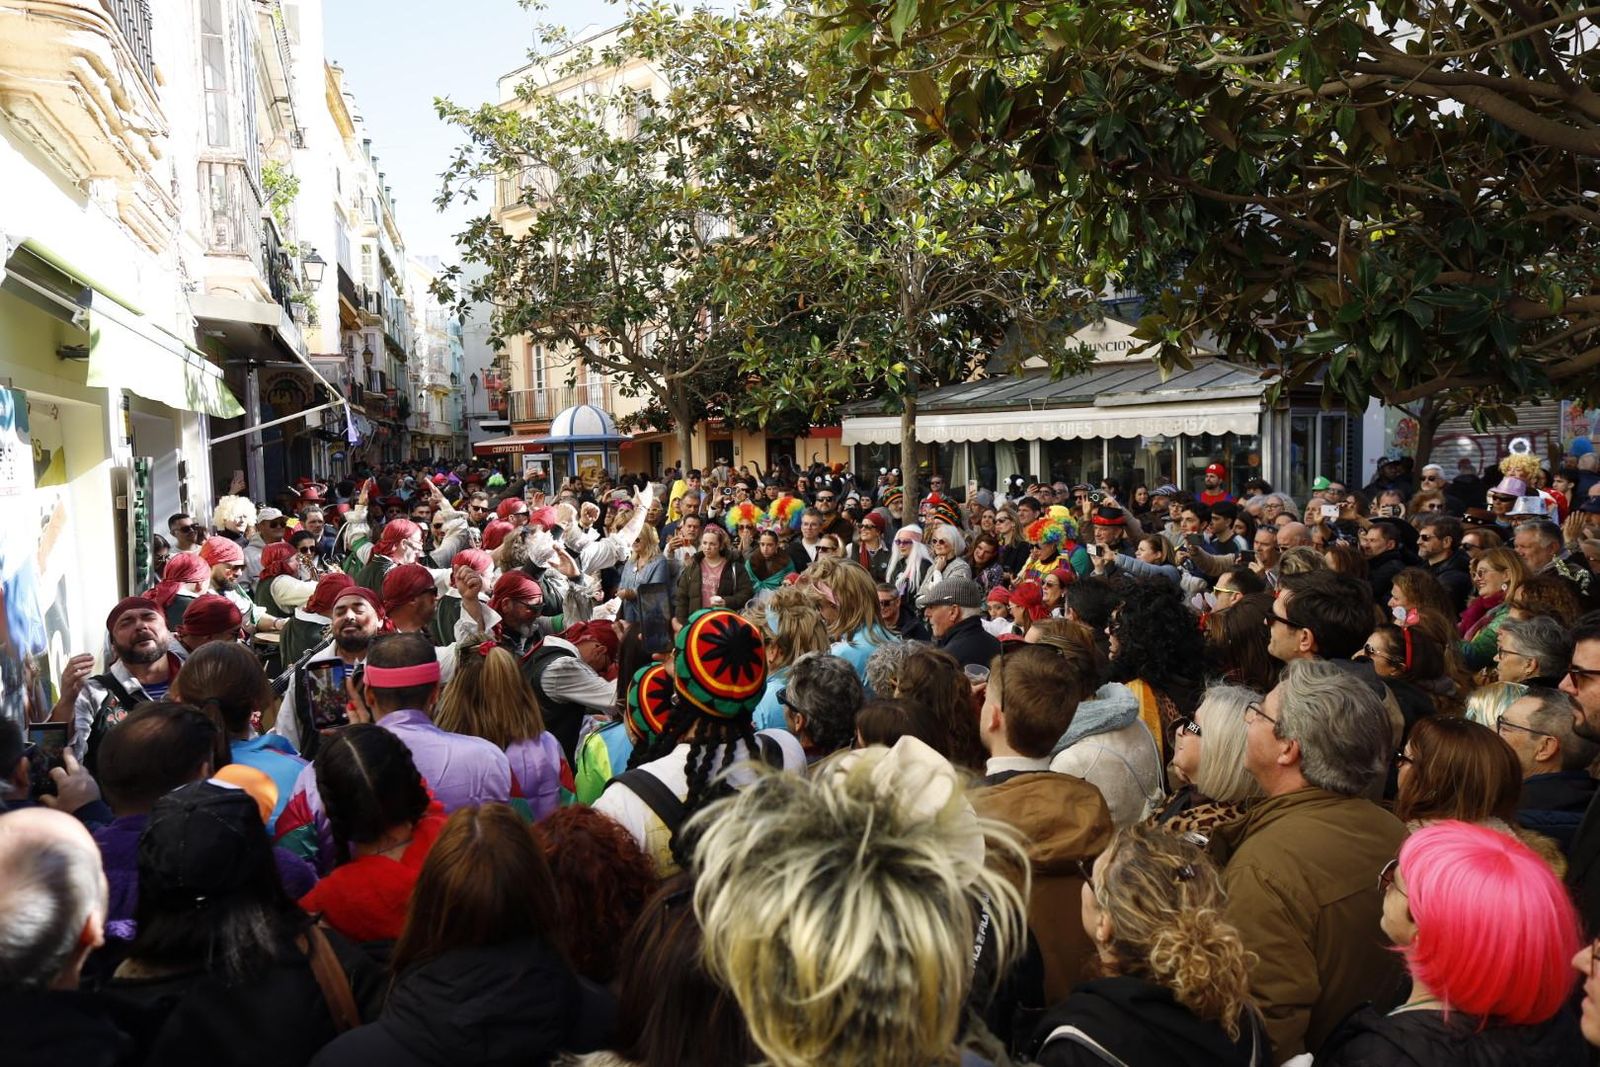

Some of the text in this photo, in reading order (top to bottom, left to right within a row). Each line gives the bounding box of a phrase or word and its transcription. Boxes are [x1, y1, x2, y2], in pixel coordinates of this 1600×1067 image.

[1074, 340, 1135, 352] UNCION
[1010, 422, 1033, 436] LAS
[1043, 421, 1092, 435] FLORES
[979, 914, 989, 935] FILA
